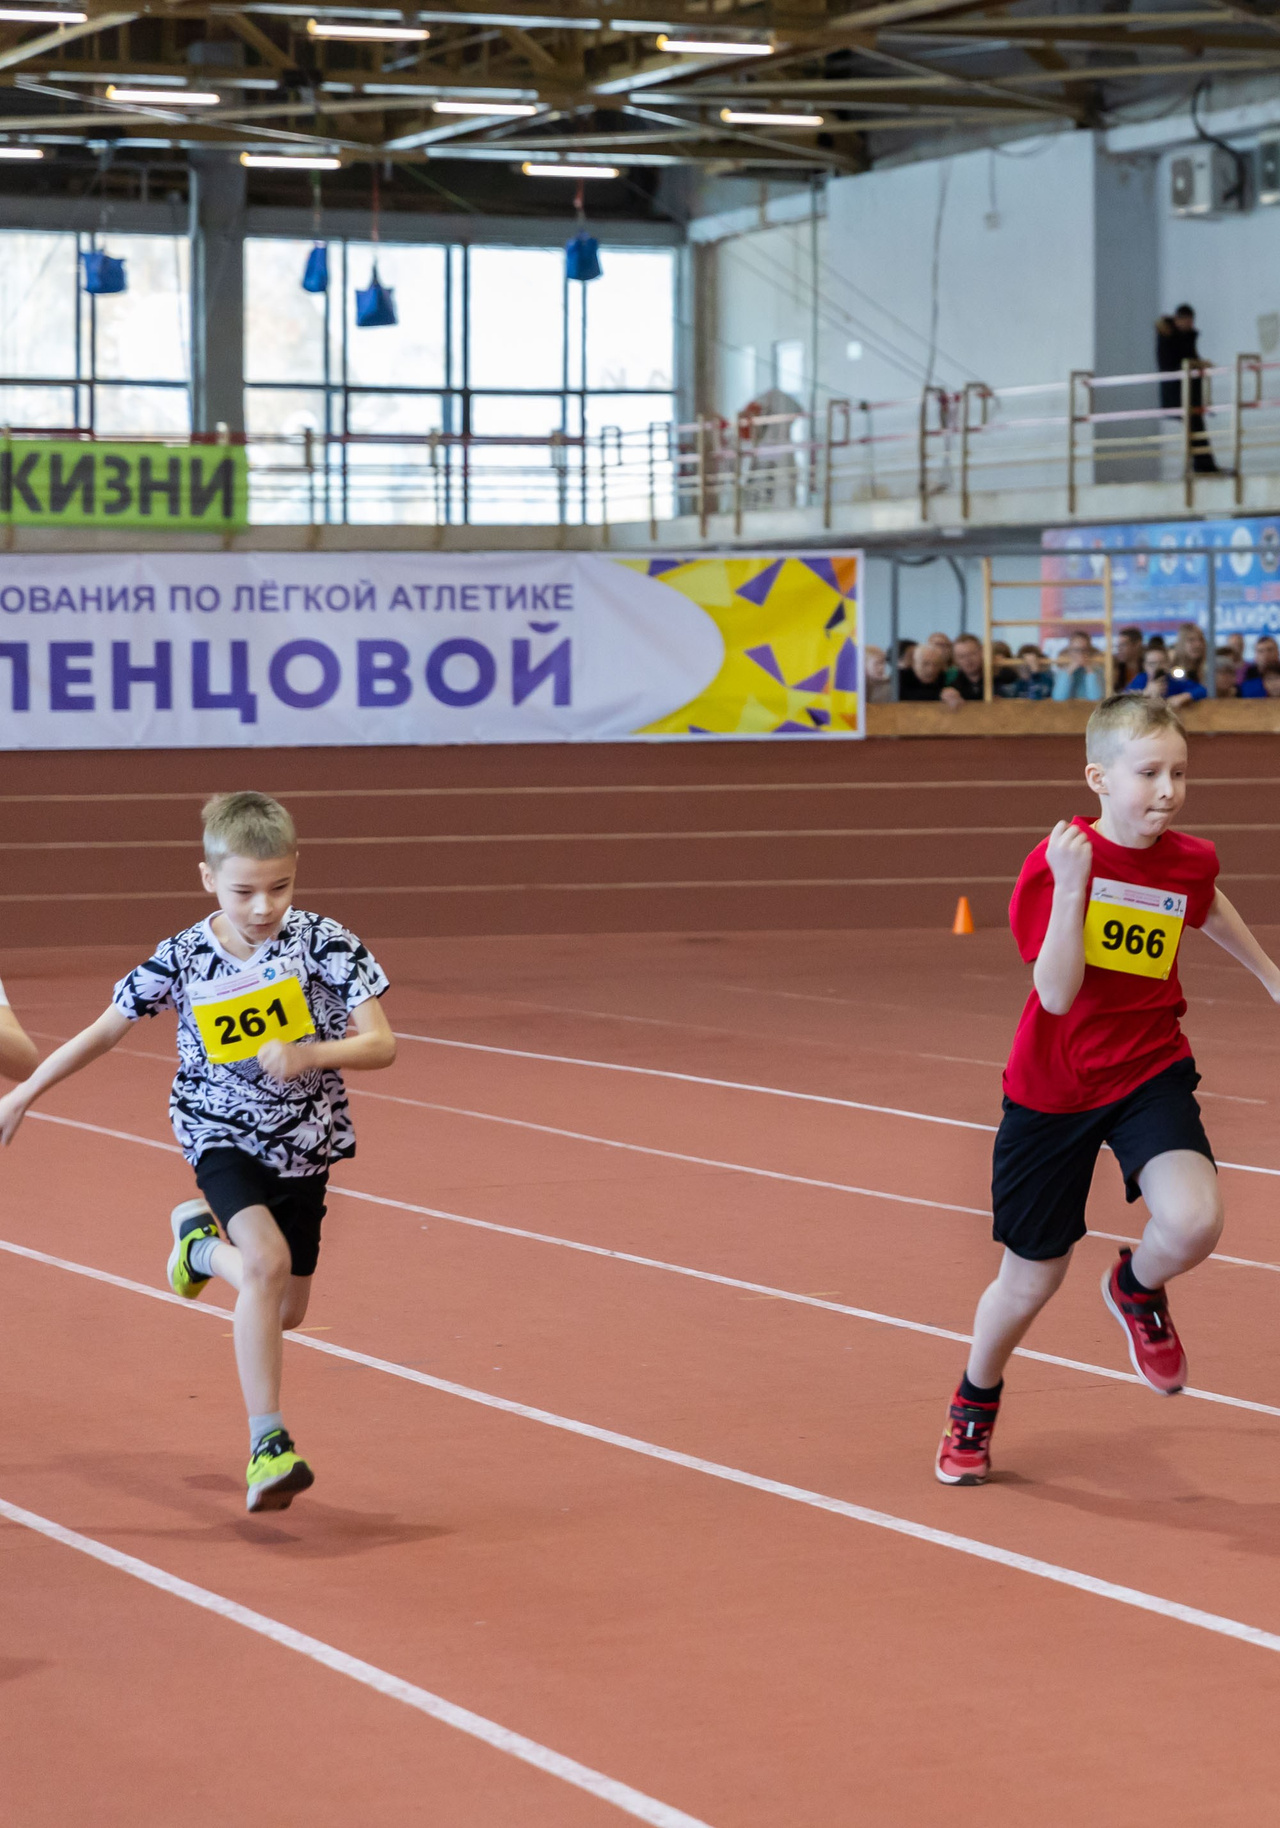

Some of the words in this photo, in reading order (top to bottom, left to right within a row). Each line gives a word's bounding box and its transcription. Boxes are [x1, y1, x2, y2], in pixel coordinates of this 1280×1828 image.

[0, 585, 156, 613] ОВАНИЯ
[169, 585, 221, 612] ПО
[232, 579, 378, 612] ЛЁГКОЙ
[388, 584, 574, 612] АТЛЕТИКЕ
[1101, 919, 1166, 959] 966
[214, 998, 288, 1045] 261
